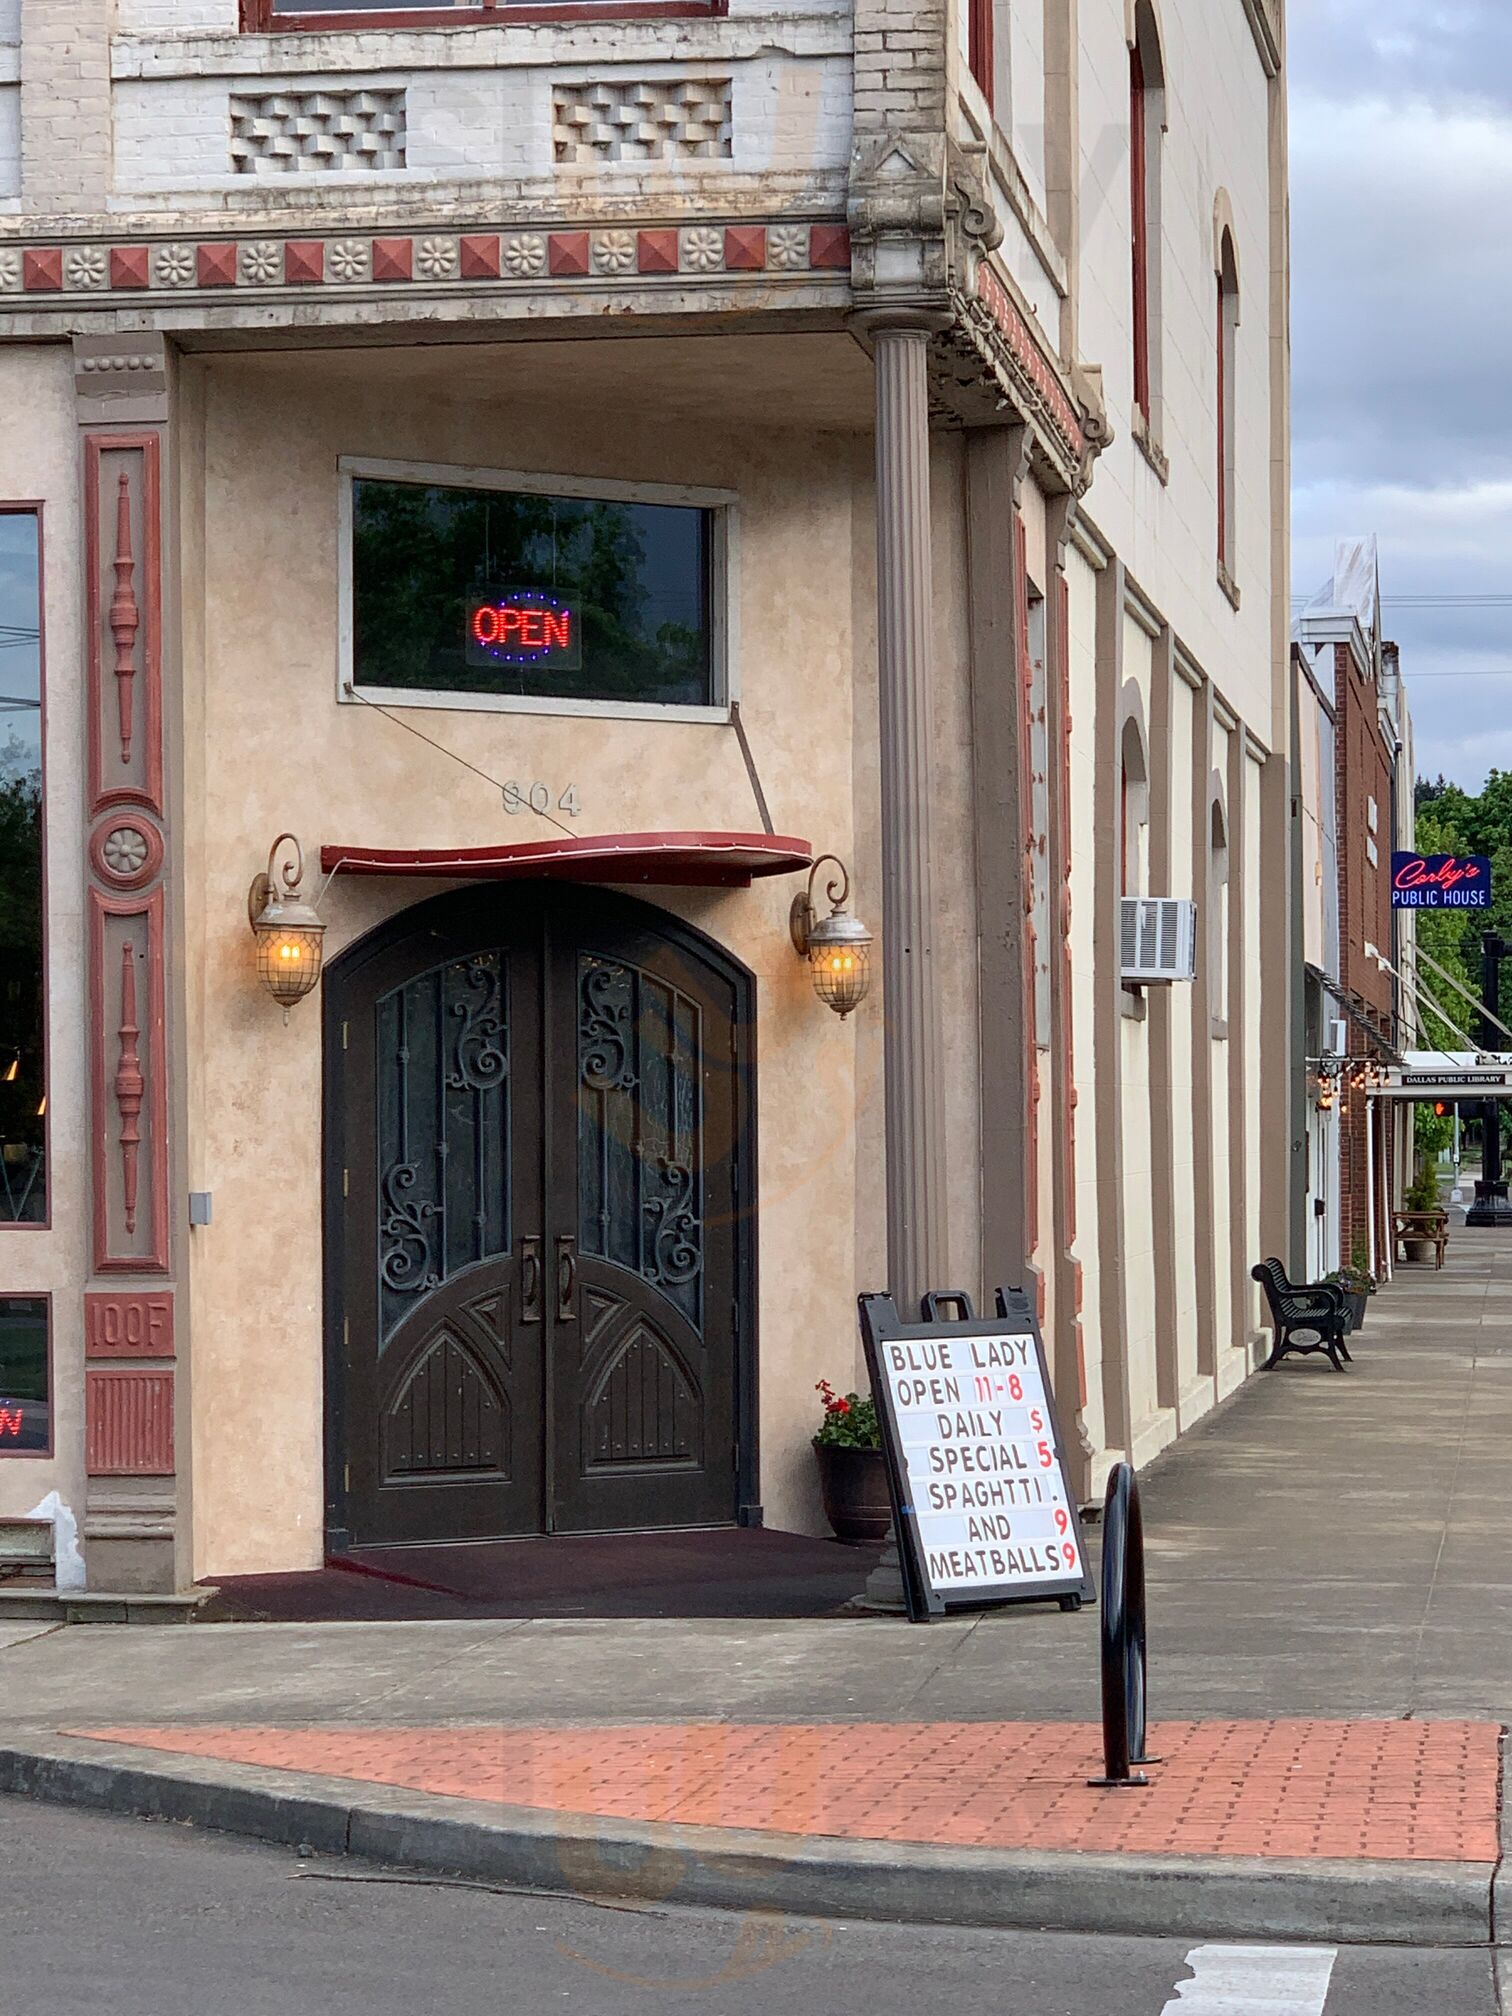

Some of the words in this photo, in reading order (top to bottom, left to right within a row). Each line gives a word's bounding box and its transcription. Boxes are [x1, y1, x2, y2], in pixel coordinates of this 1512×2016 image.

[472, 607, 570, 648] OPEN
[1392, 890, 1438, 905] PUBLIC
[1443, 890, 1486, 905] HOUSE
[1467, 1075, 1501, 1083] LIBRARY
[890, 1343, 953, 1371] BLUE
[970, 1340, 1027, 1368] LADY
[897, 1376, 961, 1406] OPEN
[974, 1373, 1024, 1402] 11-8
[937, 1409, 1003, 1440] DAILY
[929, 1443, 1027, 1474] SPECIAL
[929, 1477, 1042, 1510] SPAGHTTI
[968, 1514, 1011, 1542] AND
[929, 1544, 1061, 1580] MEATBALLS
